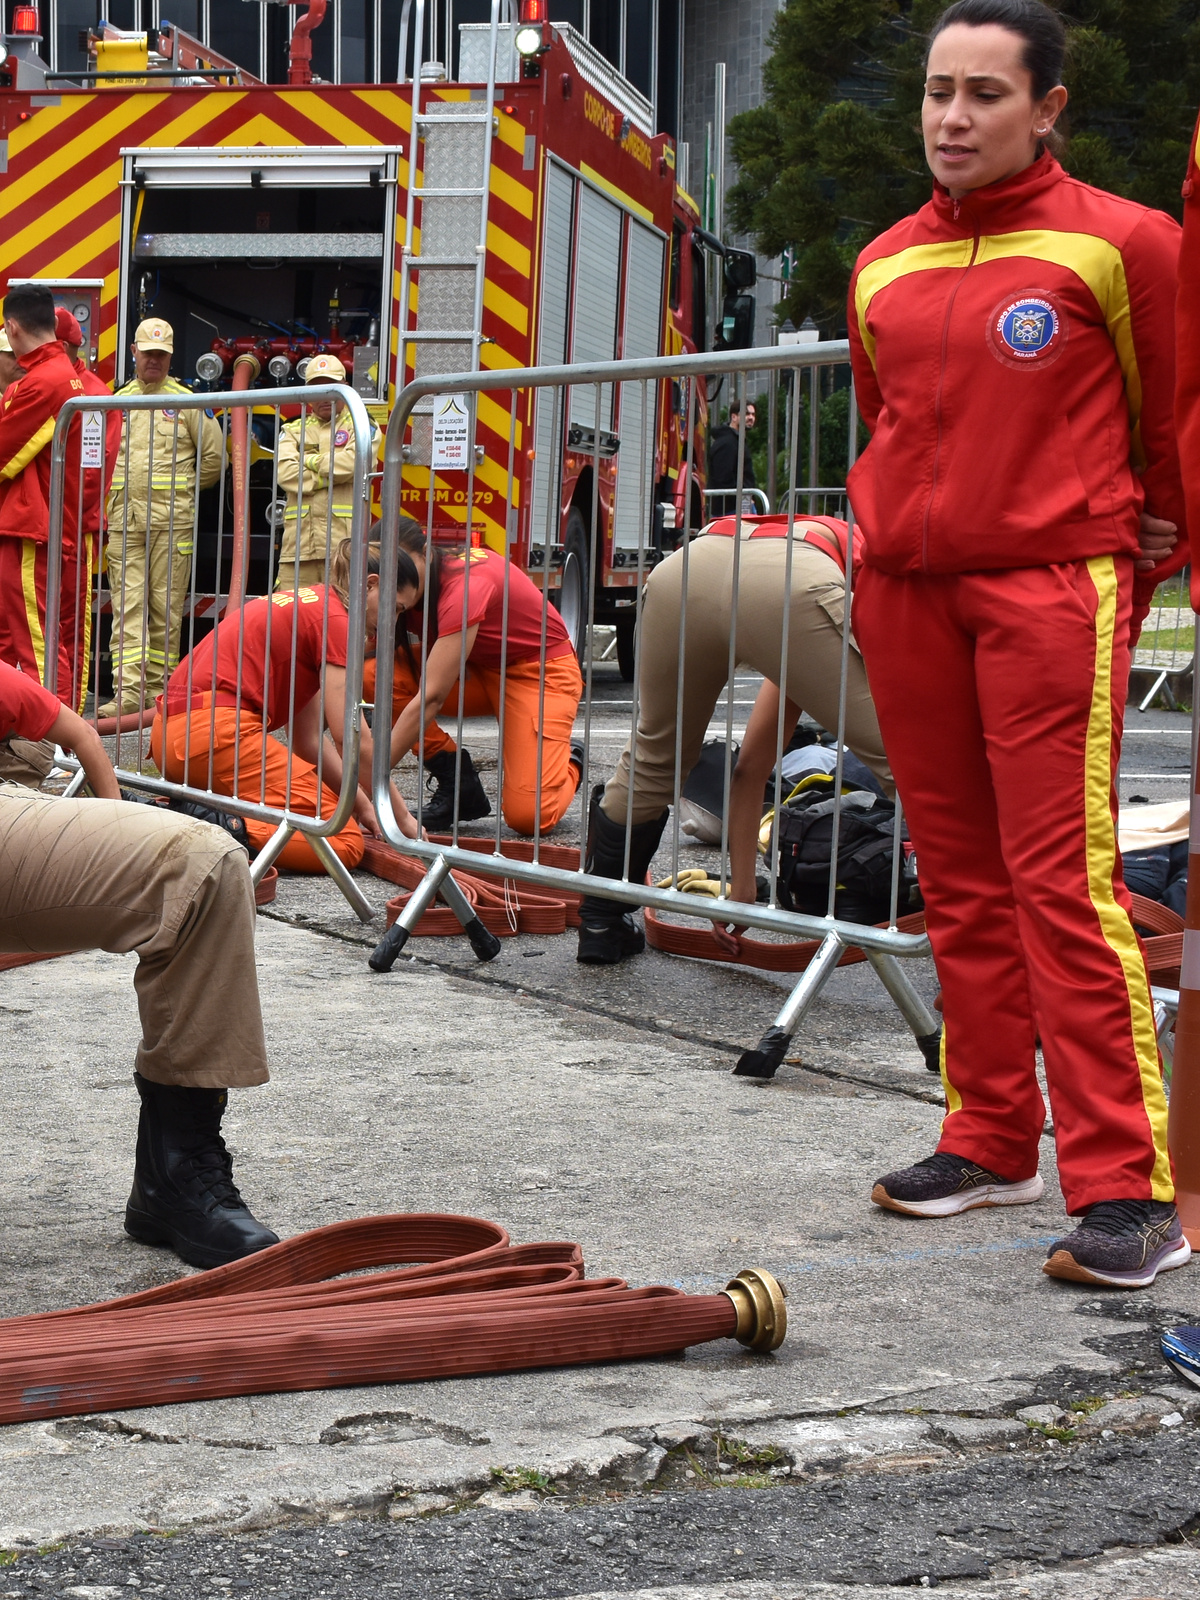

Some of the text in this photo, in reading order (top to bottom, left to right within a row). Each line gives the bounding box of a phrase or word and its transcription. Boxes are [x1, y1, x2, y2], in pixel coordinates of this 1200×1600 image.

[584, 90, 605, 132] CORPO
[605, 109, 615, 140] DE
[996, 298, 1060, 335] CORPO DE BOMBEIROS MILITAR
